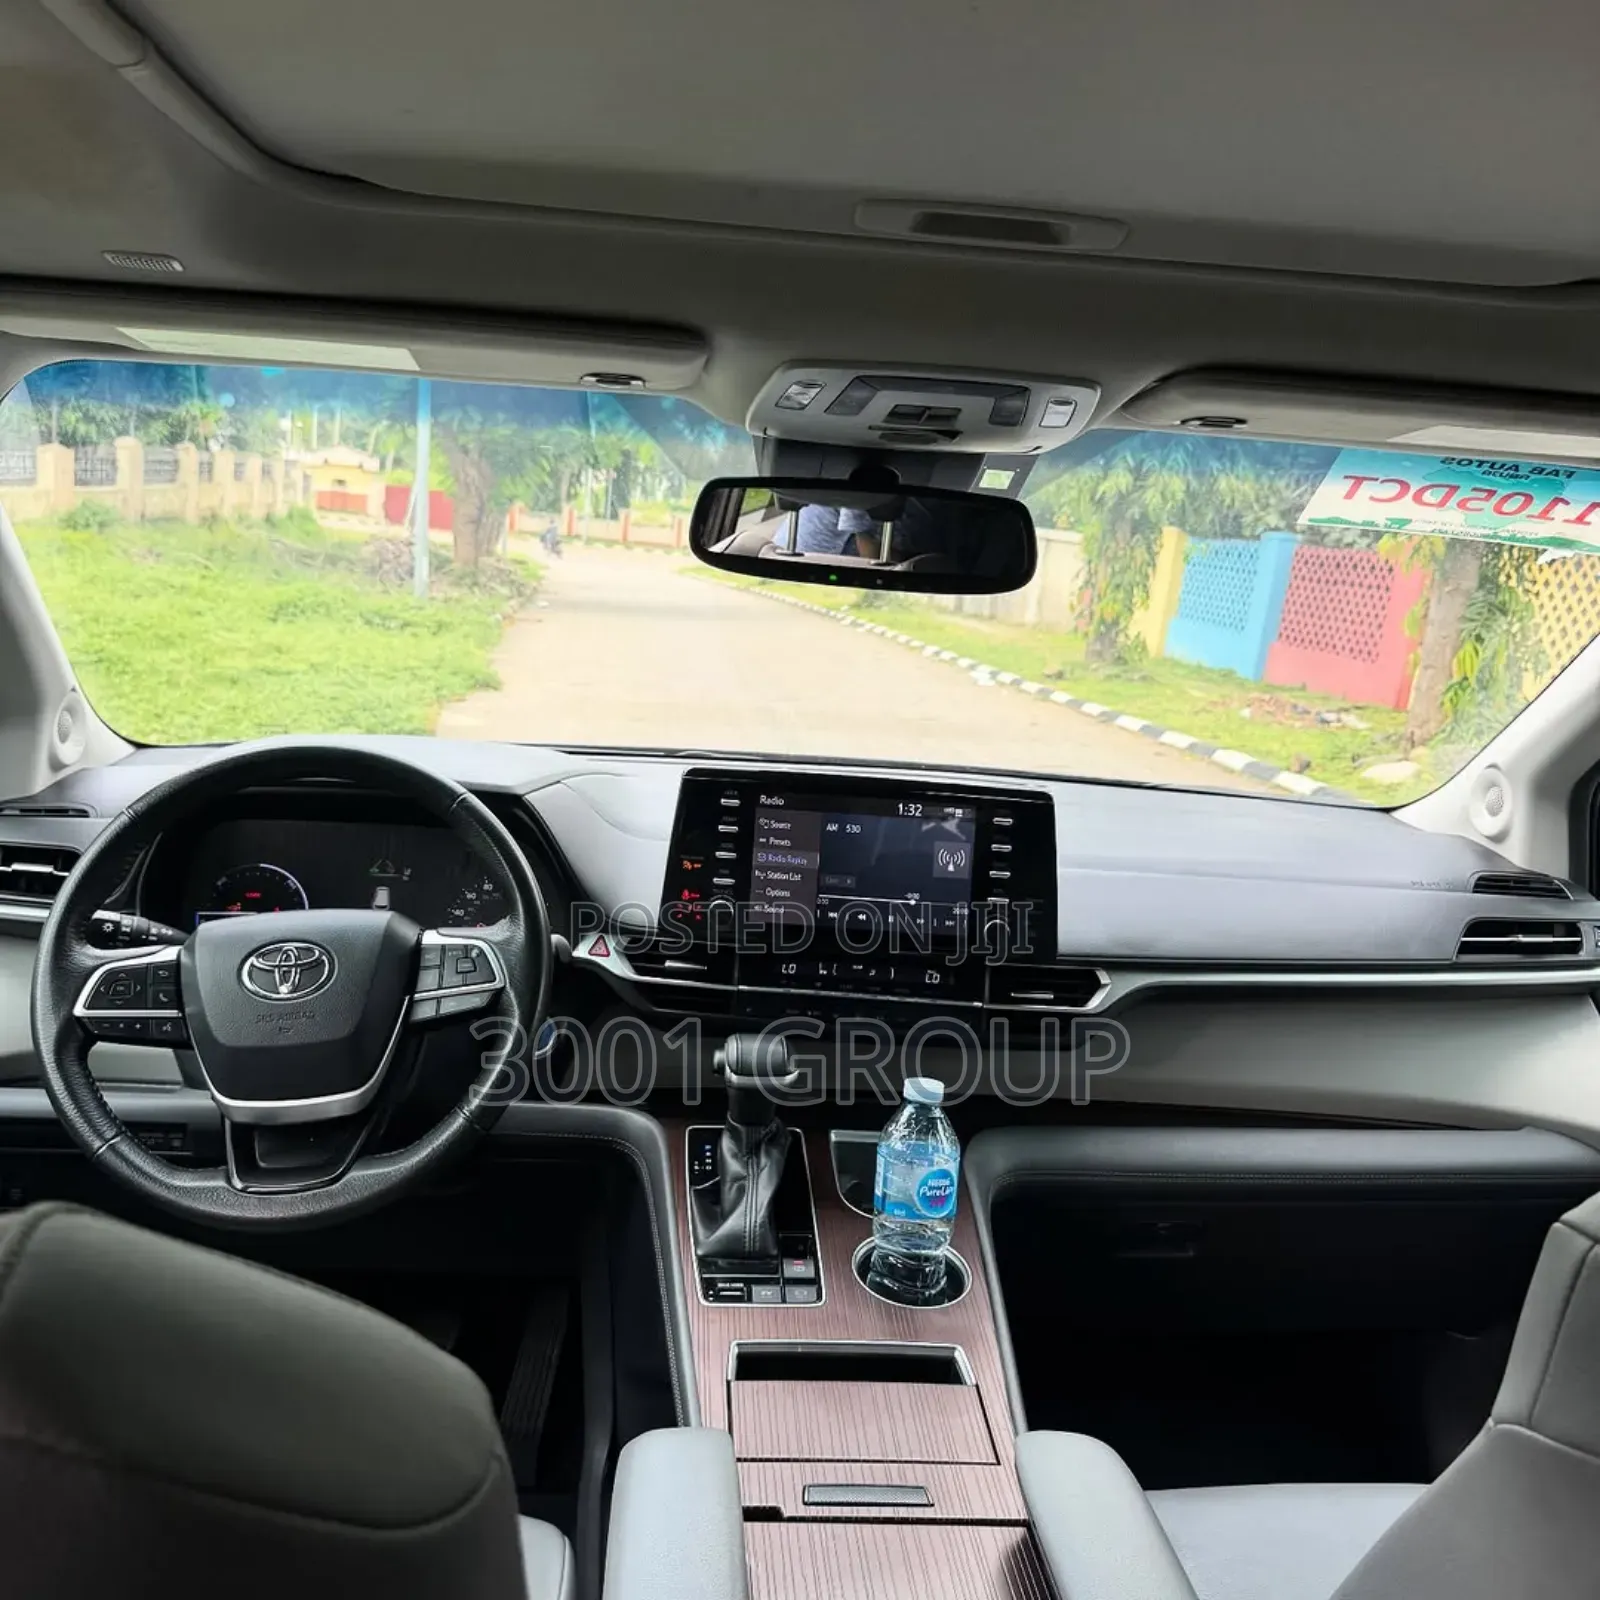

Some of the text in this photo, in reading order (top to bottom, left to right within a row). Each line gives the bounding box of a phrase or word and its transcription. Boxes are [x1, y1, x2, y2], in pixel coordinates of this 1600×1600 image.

[759, 794, 785, 806] Radio
[897, 802, 923, 817] 1:32
[770, 820, 791, 831] Source
[826, 823, 862, 834] AM 530
[767, 870, 789, 880] Station
[765, 887, 791, 898] Options
[764, 904, 784, 914] Sound
